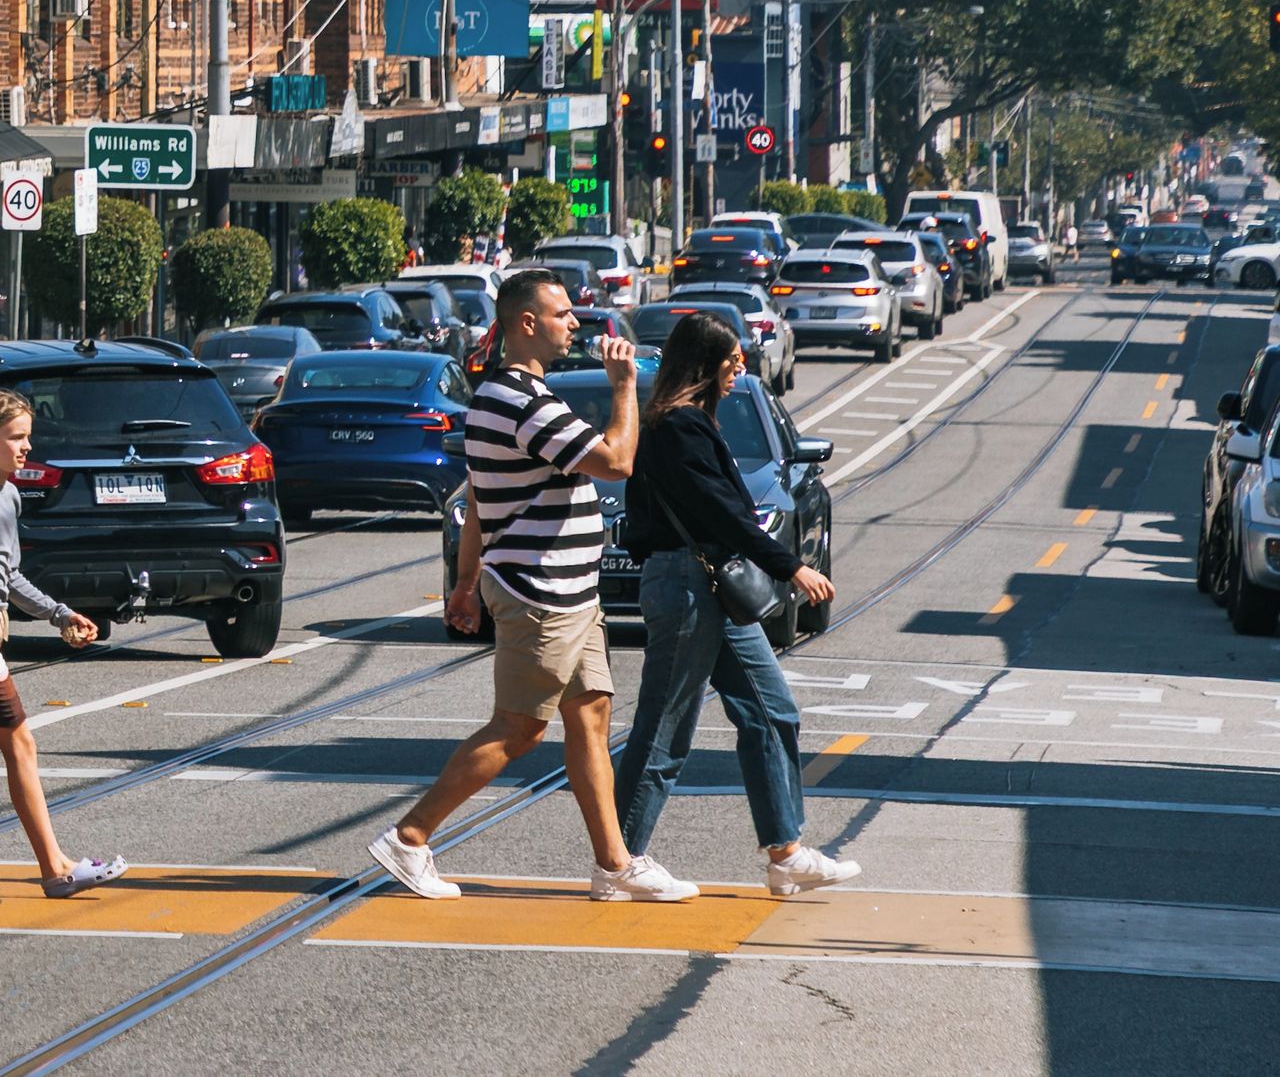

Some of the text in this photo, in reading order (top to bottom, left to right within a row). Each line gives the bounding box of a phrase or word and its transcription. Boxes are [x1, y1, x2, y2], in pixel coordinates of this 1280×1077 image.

[544, 20, 556, 86] LEASE
[714, 87, 754, 113] orty
[94, 135, 187, 152] Williams Rd
[751, 133, 770, 148] 40
[134, 161, 147, 173] 25
[10, 190, 37, 210] 40
[332, 430, 351, 440] CRV
[601, 558, 617, 570] CG
